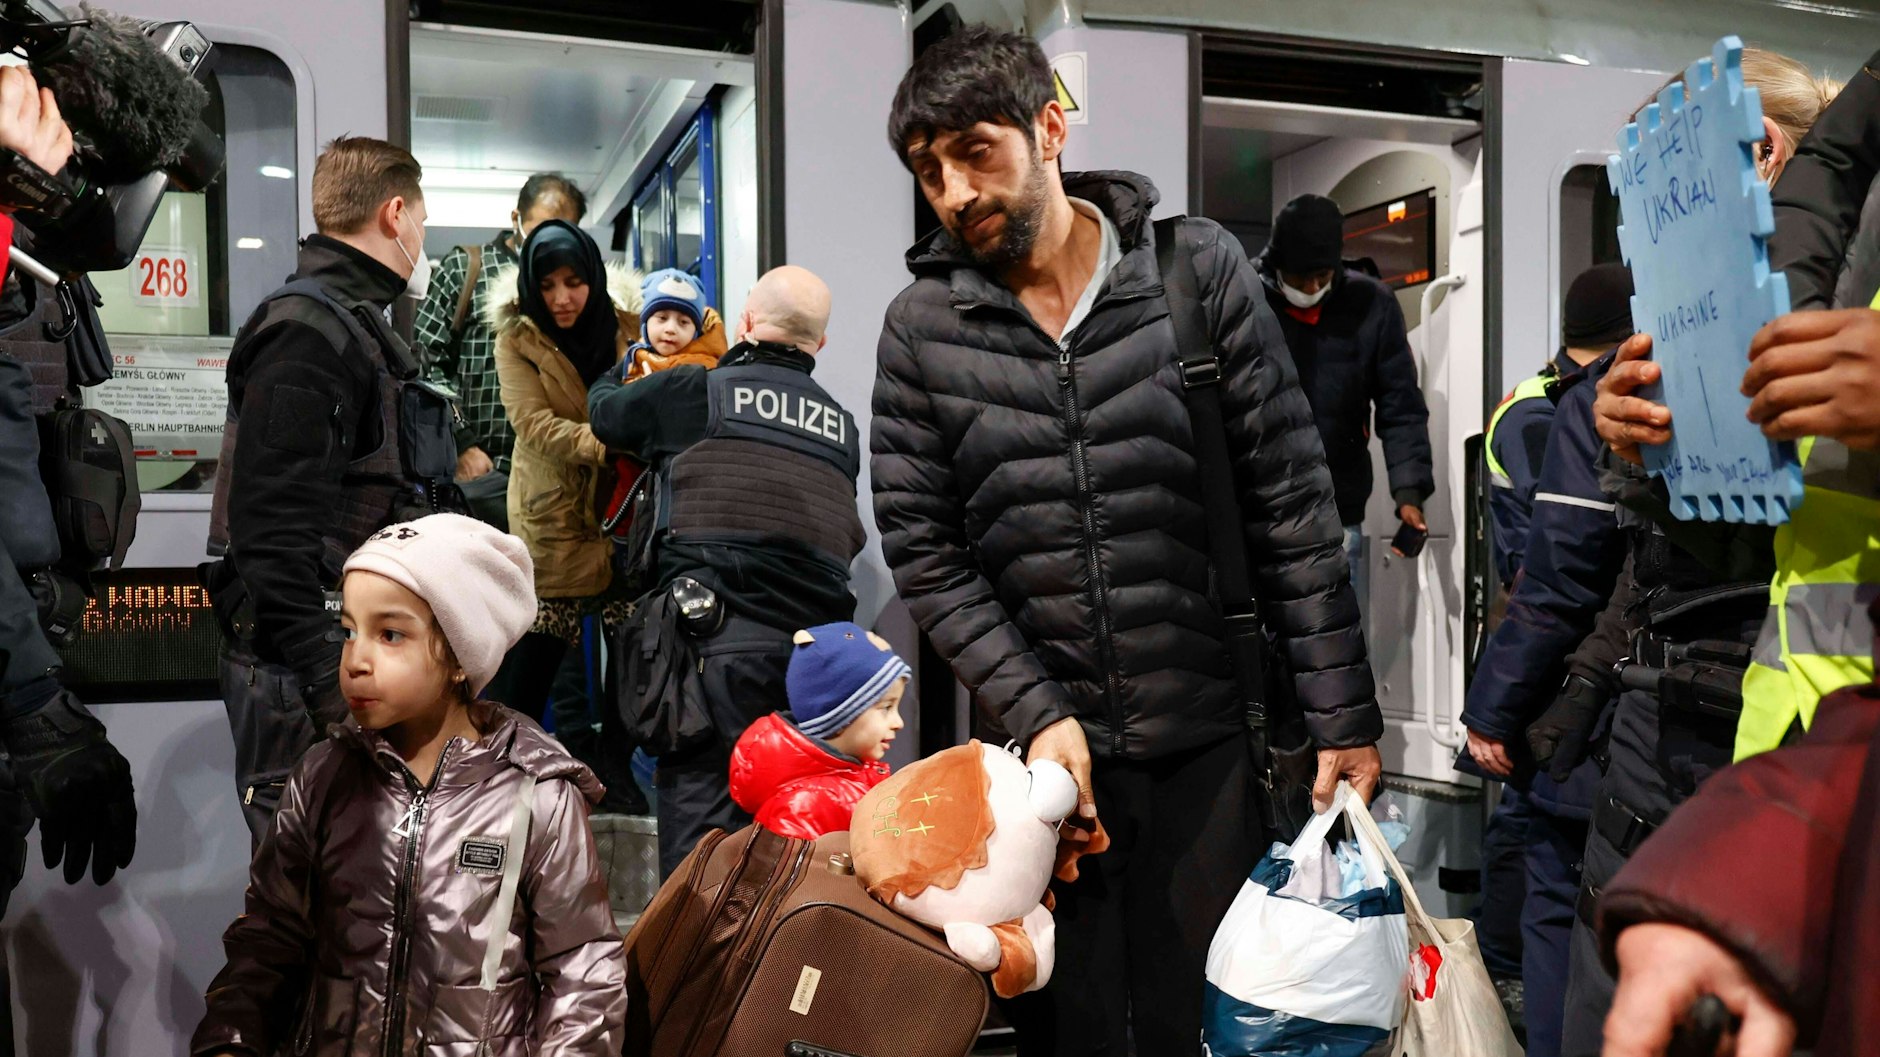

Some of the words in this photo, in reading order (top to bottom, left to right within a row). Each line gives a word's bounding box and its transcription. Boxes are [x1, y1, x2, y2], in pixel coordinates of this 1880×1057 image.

[1619, 152, 1647, 194] WE
[139, 257, 188, 298] 268
[1658, 289, 1719, 342] UKRAINE
[124, 356, 136, 365] 56
[197, 358, 228, 368] WAWE
[147, 371, 186, 381] GŁÓWNY
[130, 422, 155, 433] ERLIN
[157, 423, 224, 434] HAUPTBAHNHO
[734, 387, 846, 445] POLIZEI
